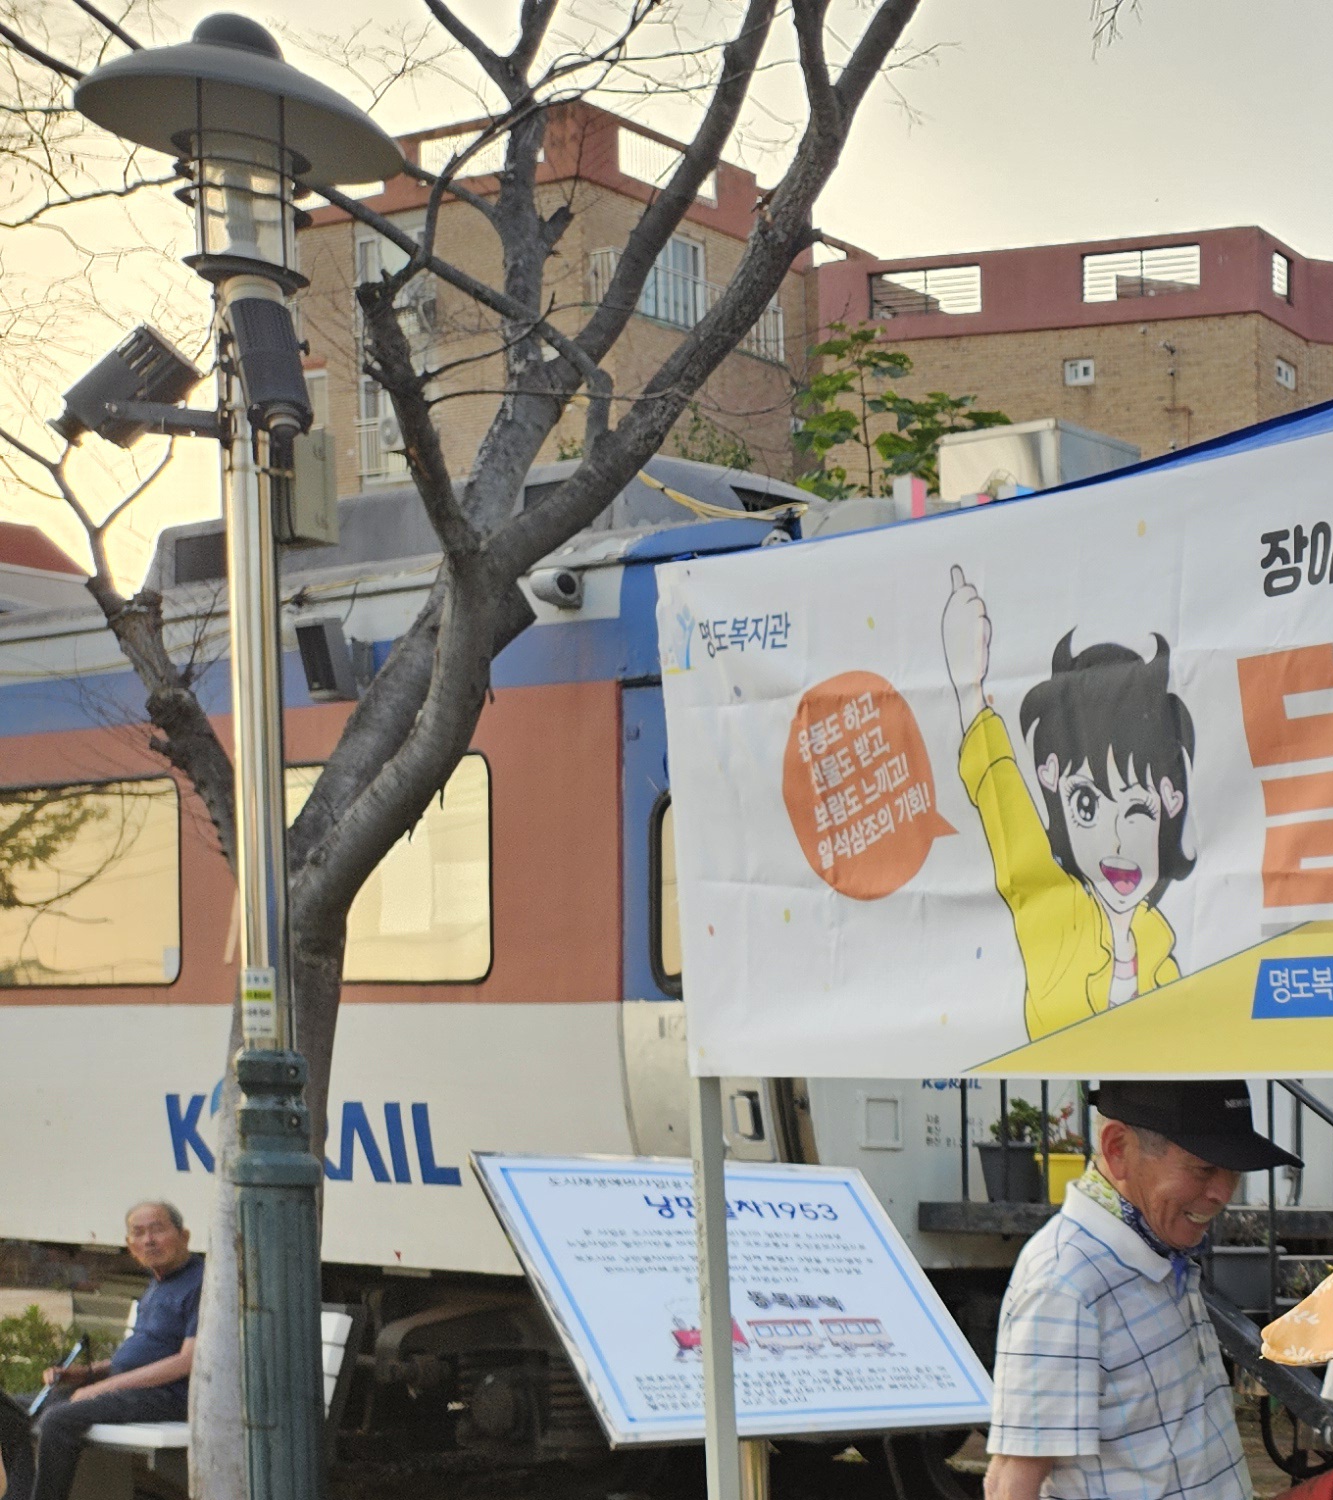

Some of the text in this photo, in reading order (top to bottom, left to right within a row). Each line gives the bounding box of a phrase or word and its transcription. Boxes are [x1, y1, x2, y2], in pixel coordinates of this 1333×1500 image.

[698, 611, 791, 659] 명도복지관
[813, 786, 864, 833] 보람도
[817, 803, 896, 870] 일석삼조의
